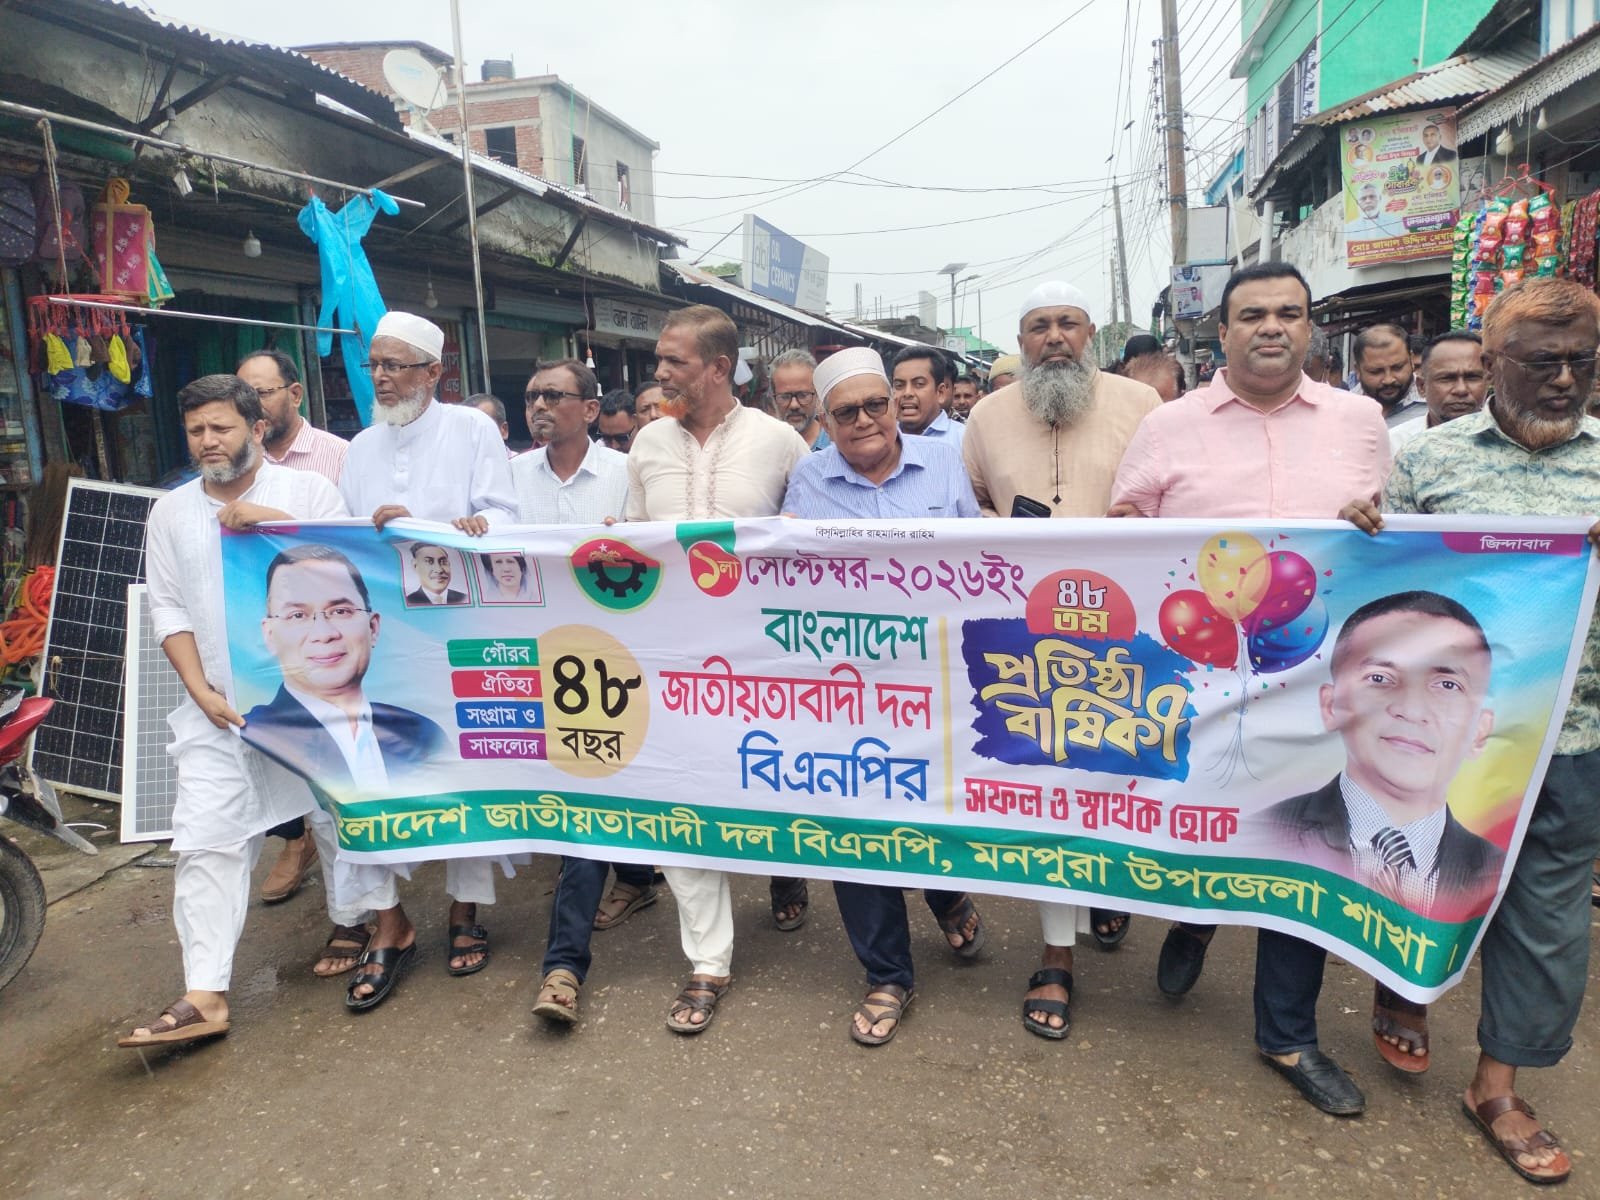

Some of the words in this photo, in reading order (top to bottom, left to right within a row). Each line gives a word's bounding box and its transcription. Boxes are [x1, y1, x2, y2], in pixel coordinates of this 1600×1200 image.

[866, 528, 906, 538] রাহমানির
[909, 529, 935, 539] রাহিম
[1480, 535, 1554, 550] জিন্দাবাদ
[1057, 578, 1107, 609] ৪৮
[761, 607, 928, 662] বাংলাদেশ
[1052, 607, 1110, 633] তম
[482, 640, 531, 664] গৌরব
[481, 671, 534, 696] ঐতিহ্য
[553, 655, 642, 719] ৪৮
[659, 655, 865, 725] জাতীয়তাবাদী
[875, 682, 932, 729] দল
[465, 706, 518, 726] সংগ্রাম
[522, 710, 536, 724] ও
[468, 736, 540, 756] সাফল্যের
[556, 726, 626, 764] বছর
[737, 730, 929, 801] বিএনপির
[964, 777, 1042, 818] সফল
[1050, 788, 1069, 821] ও
[1169, 804, 1240, 844] হোক
[482, 794, 710, 847] জাতীয়তাবাদী
[716, 821, 778, 854] দল
[967, 840, 1114, 888] মনপুরা
[1124, 850, 1328, 919] উপজেলা
[1338, 894, 1438, 976] শাখা
